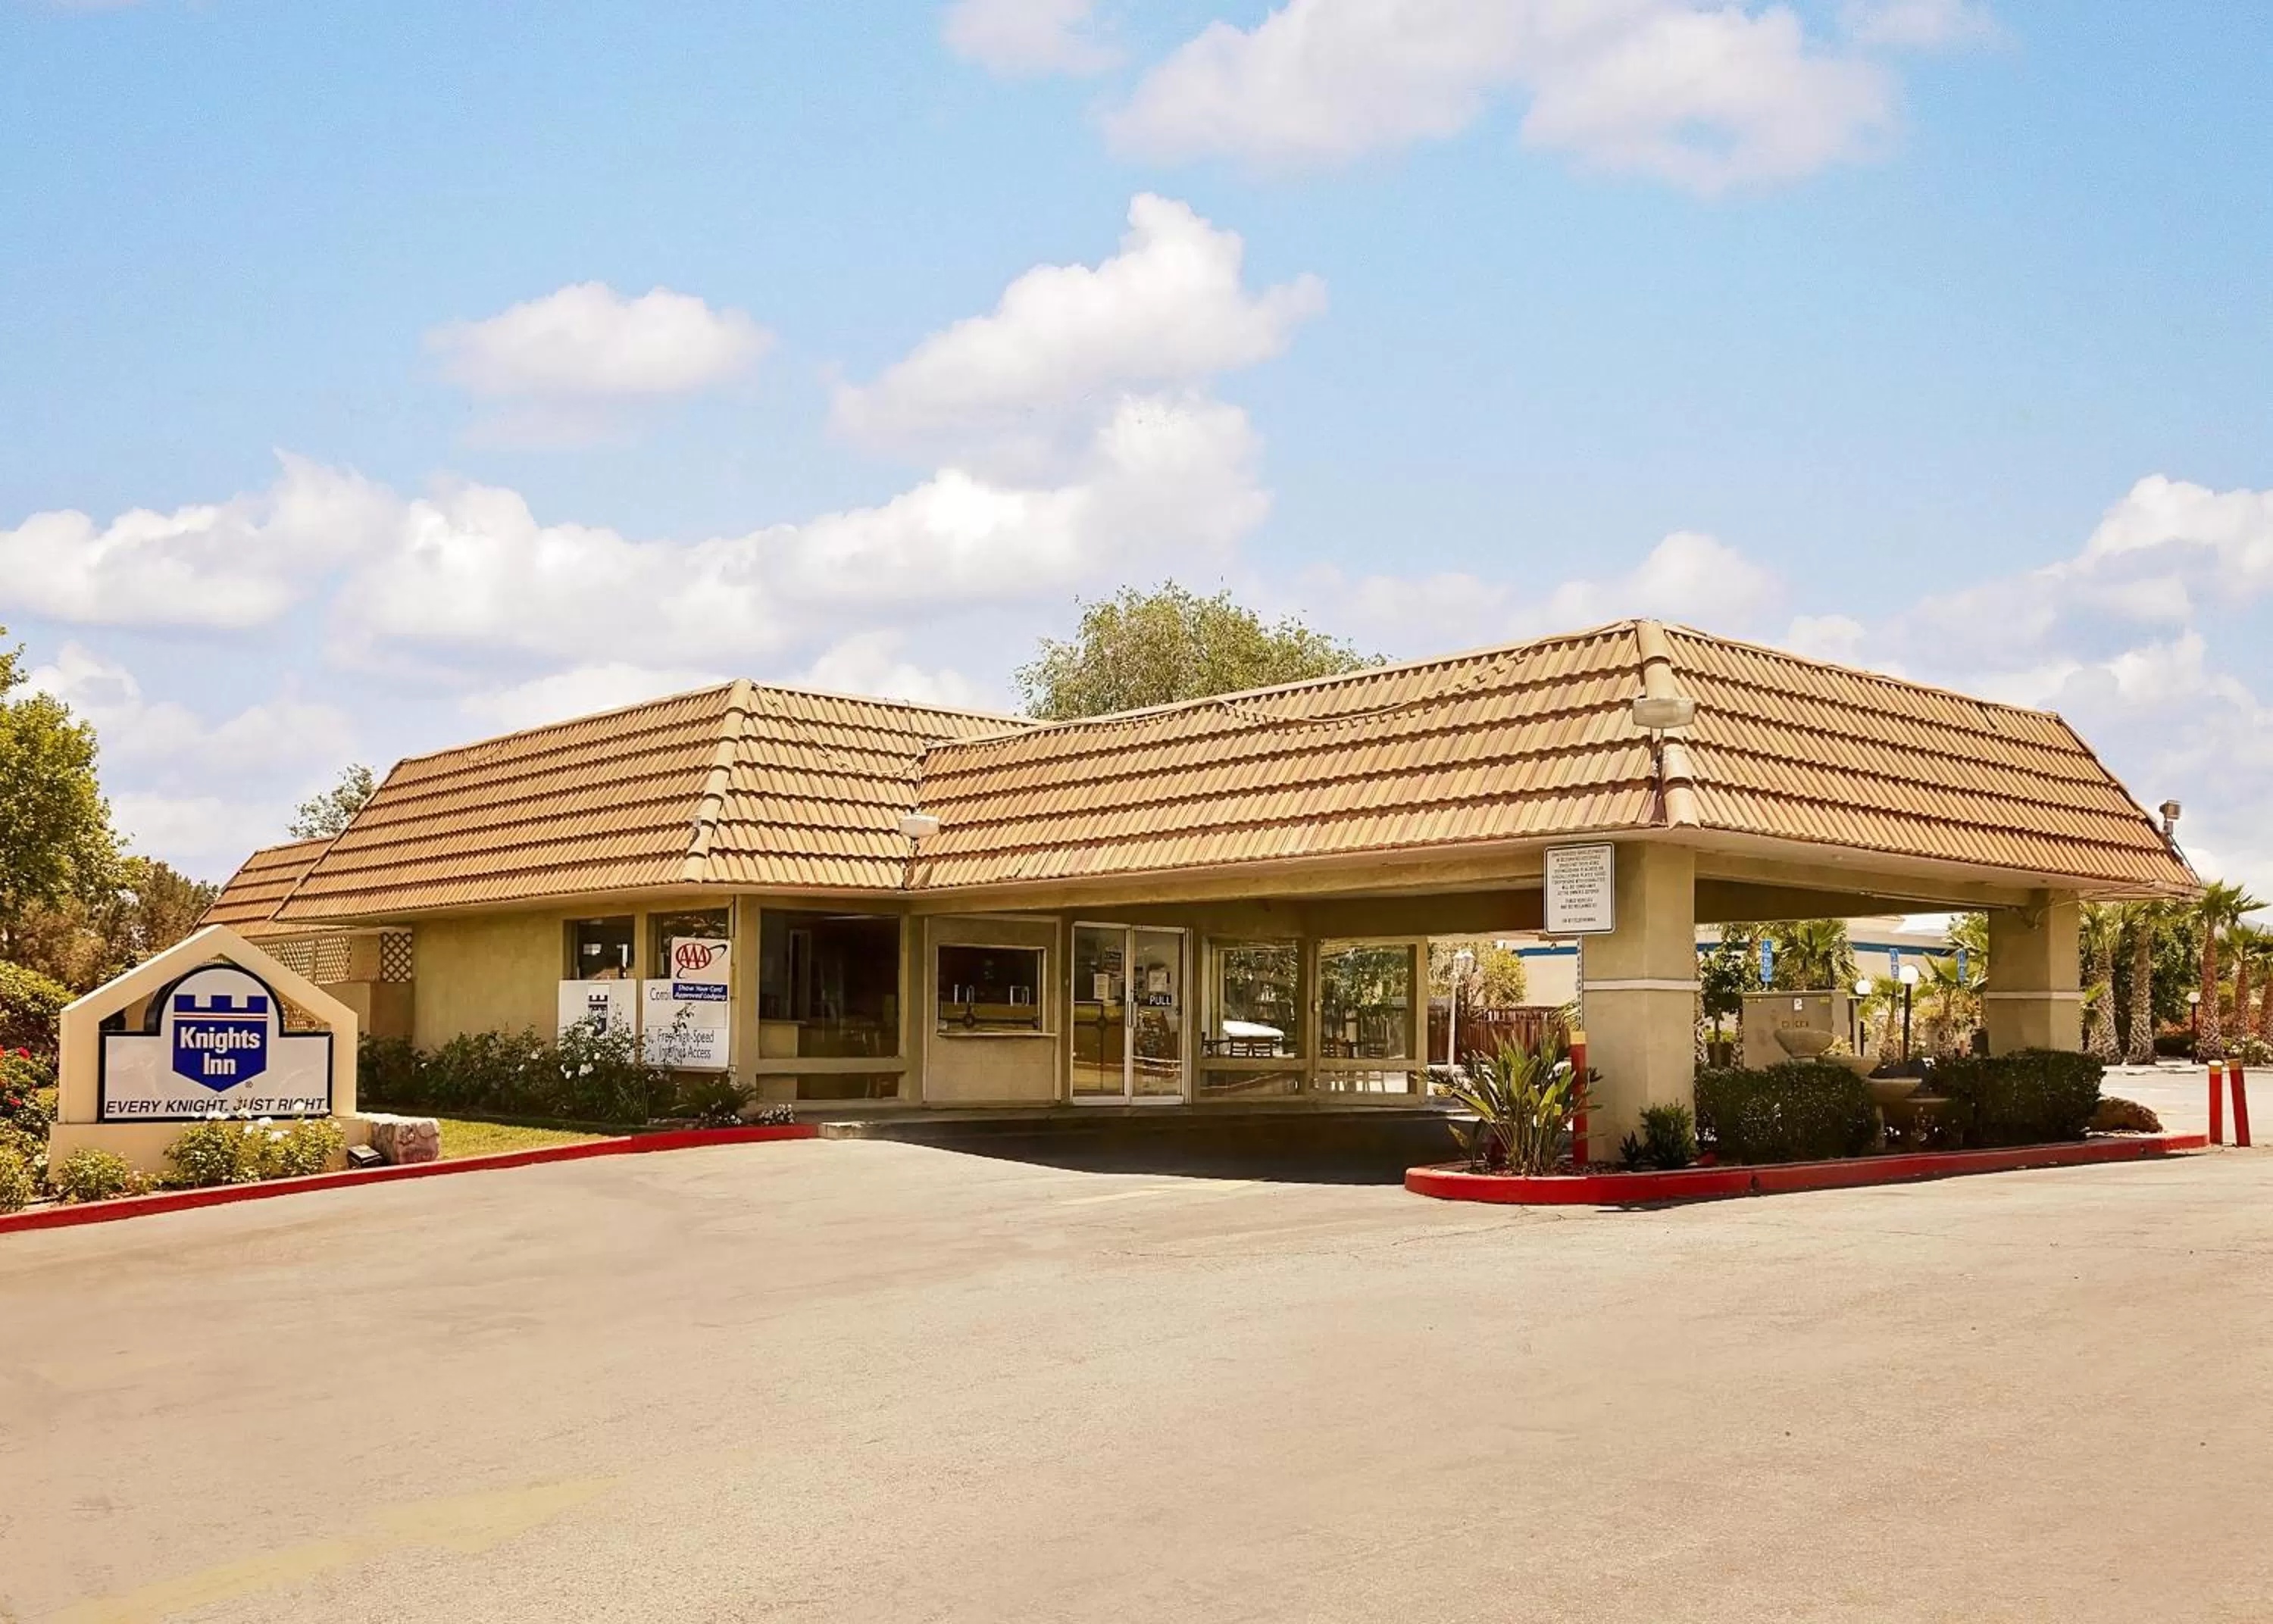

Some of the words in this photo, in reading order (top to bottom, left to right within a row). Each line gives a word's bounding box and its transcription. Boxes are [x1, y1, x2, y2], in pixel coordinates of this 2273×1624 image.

[678, 944, 709, 970] AAA
[1149, 995, 1171, 1005] PULL
[180, 1026, 261, 1054] Knights
[687, 1045, 712, 1059] Access
[203, 1052, 236, 1075] Inn
[105, 1100, 161, 1113] EVERY
